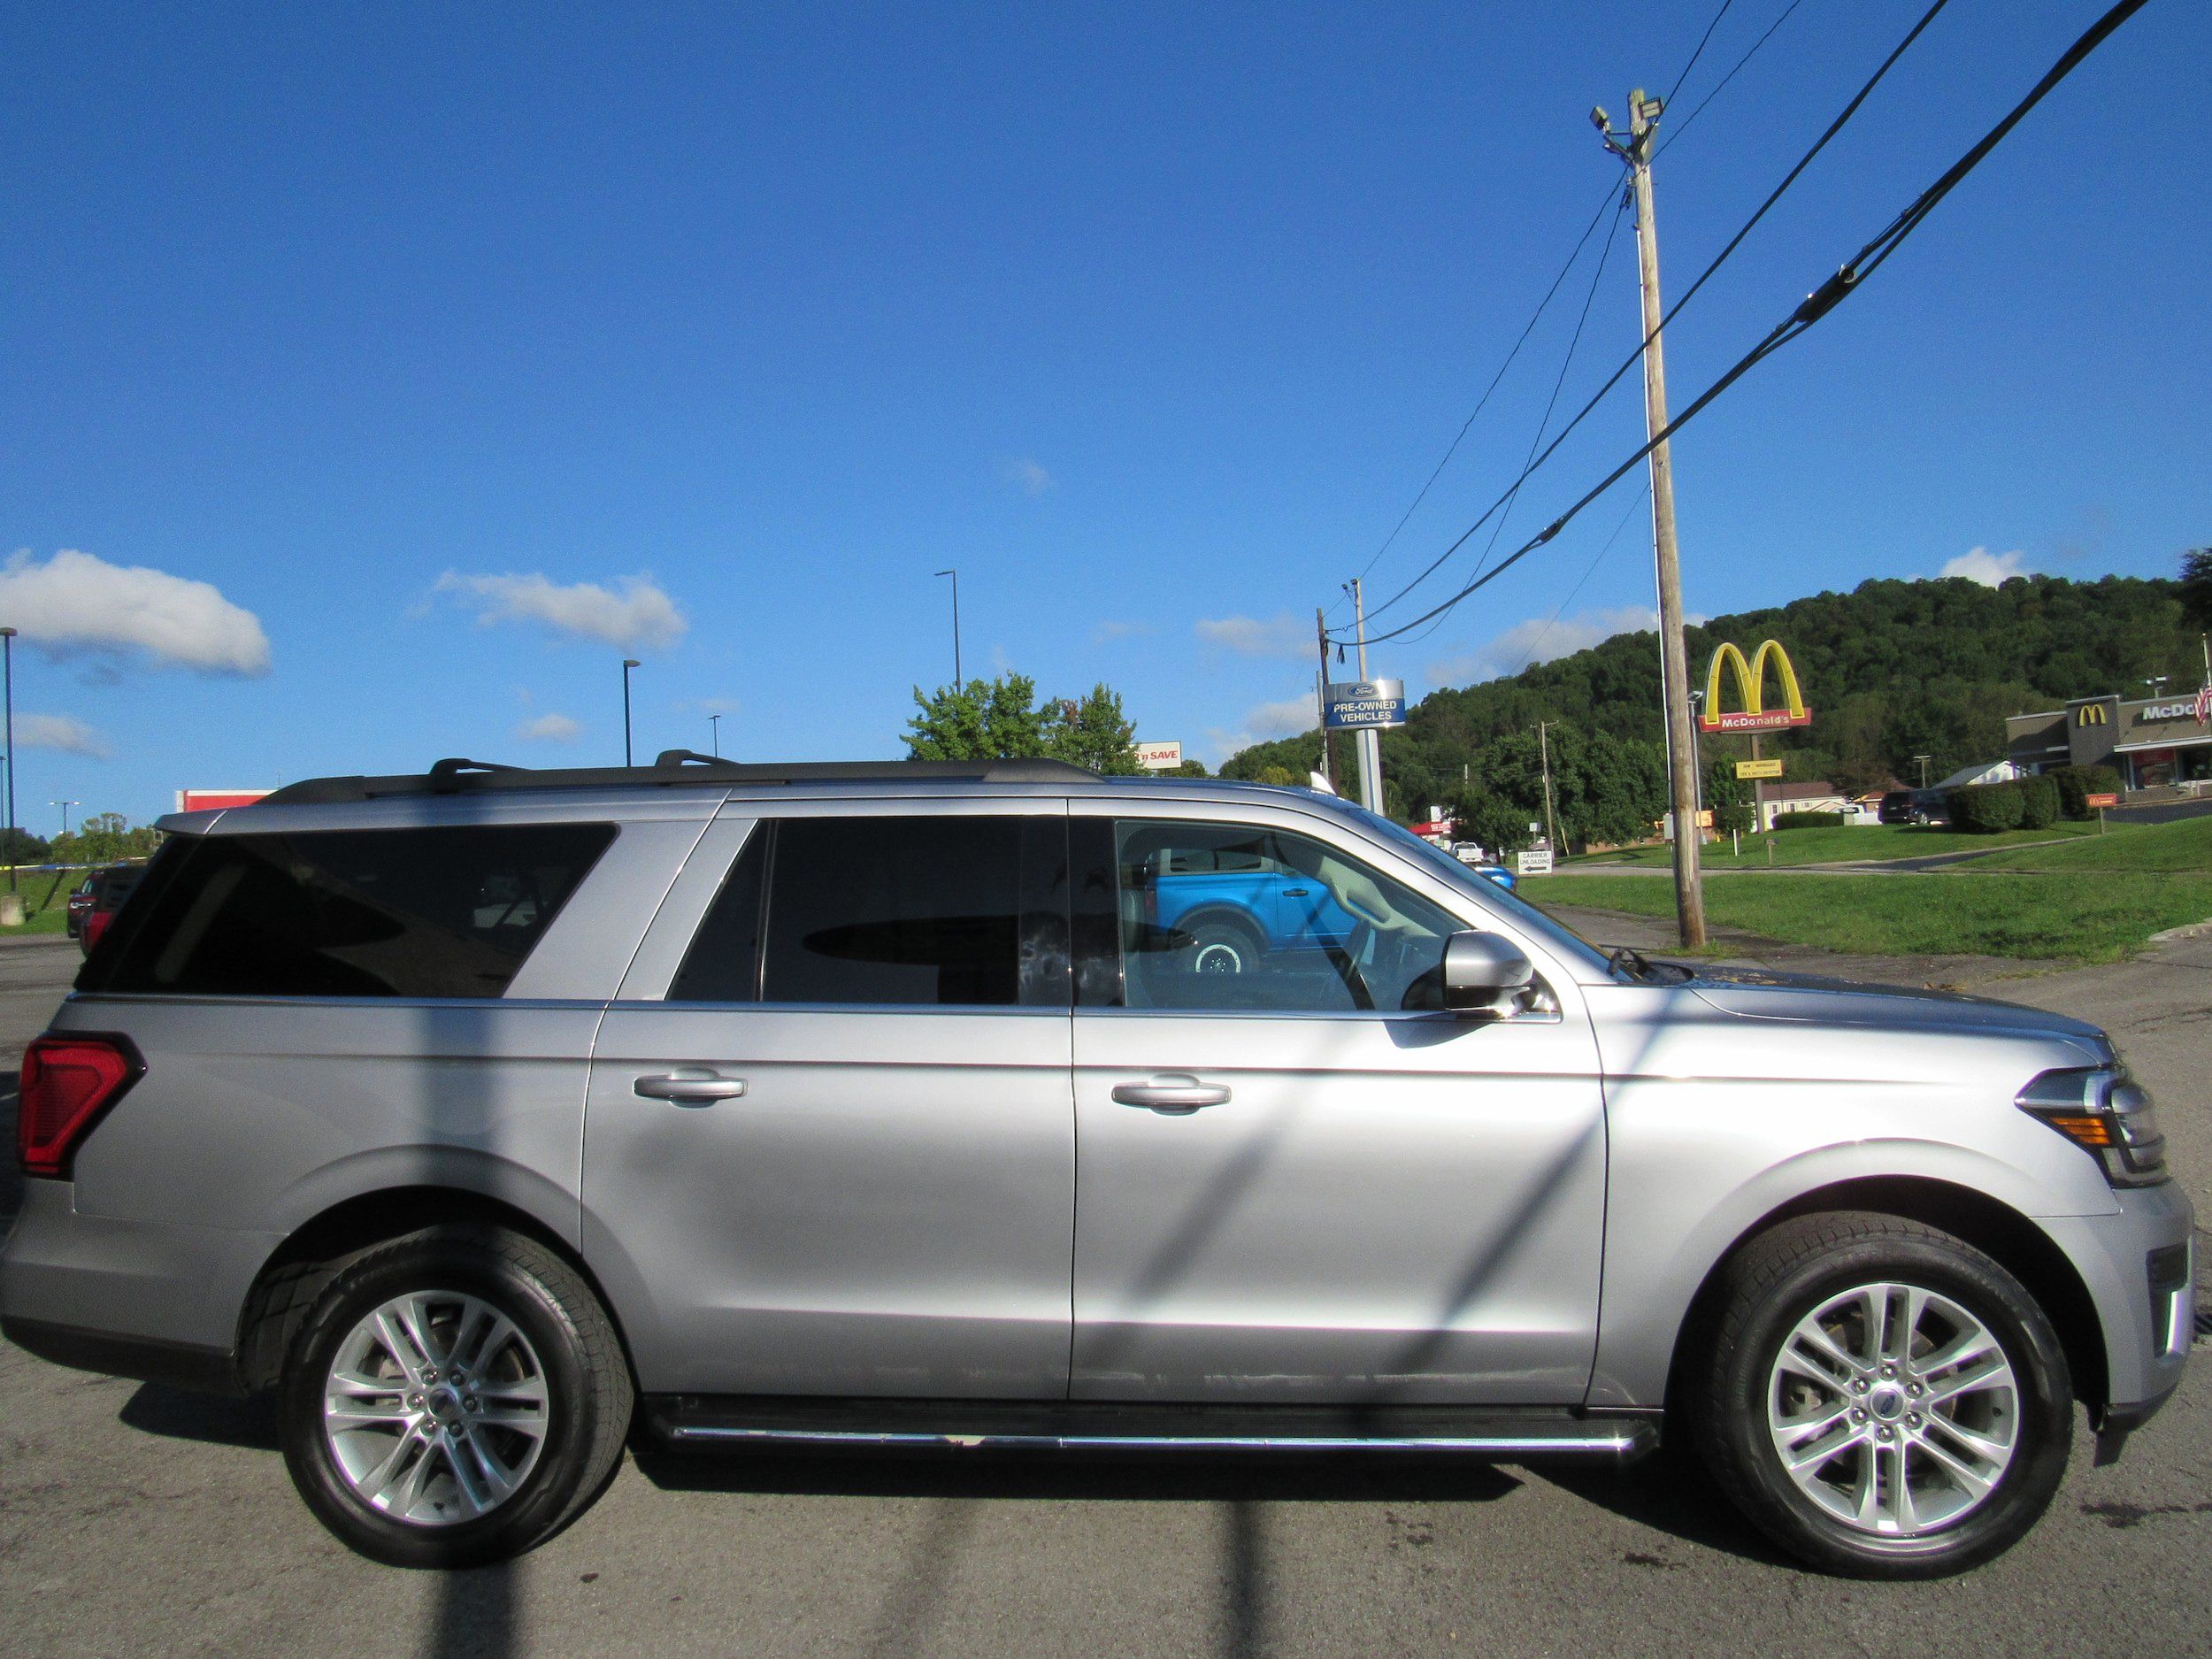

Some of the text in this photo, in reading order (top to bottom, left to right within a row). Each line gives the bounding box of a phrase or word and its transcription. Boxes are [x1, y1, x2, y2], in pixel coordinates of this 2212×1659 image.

[1333, 700, 1397, 713] PRE-OWNED
[1340, 711, 1392, 723] VEHICLES
[1722, 715, 1790, 728] McDonald's
[1149, 749, 1179, 760] SAVE
